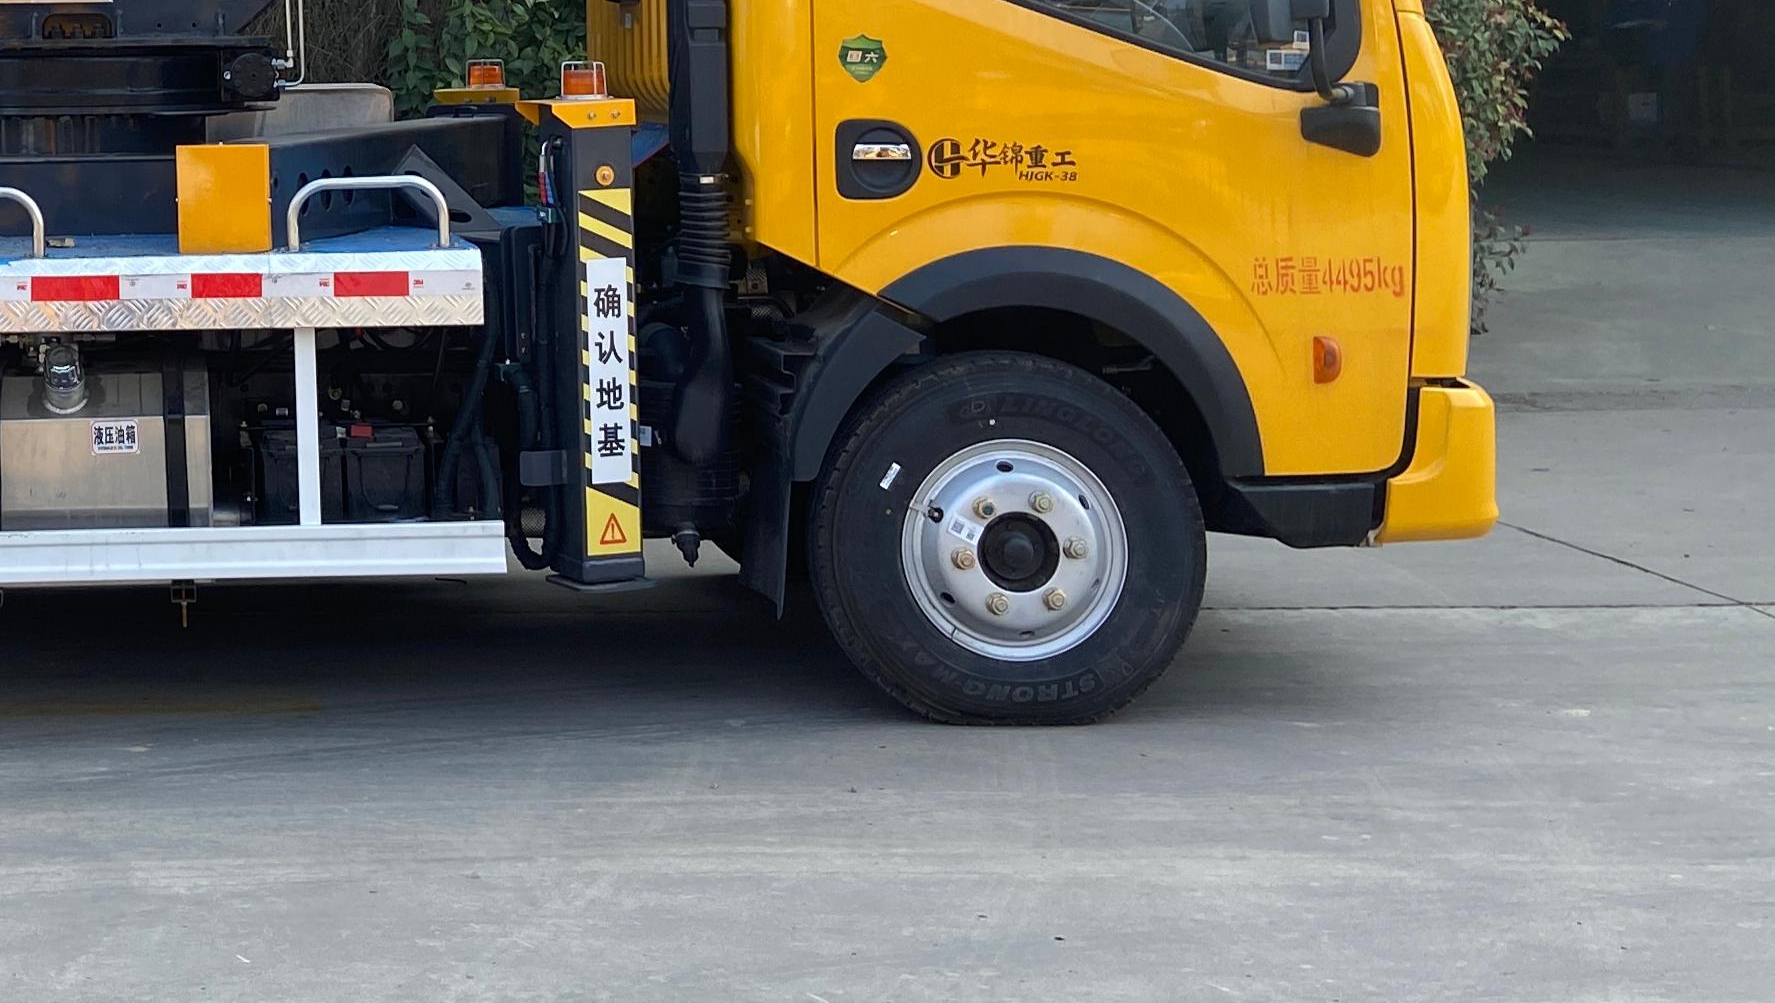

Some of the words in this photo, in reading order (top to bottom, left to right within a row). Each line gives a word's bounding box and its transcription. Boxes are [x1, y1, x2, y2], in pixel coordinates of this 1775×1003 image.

[846, 50, 879, 63] 国六
[967, 137, 1076, 178] 华锦重工
[1250, 255, 1405, 298] 总质量4495kg
[593, 283, 626, 458] 确认地基
[93, 425, 136, 445] 液压油箱
